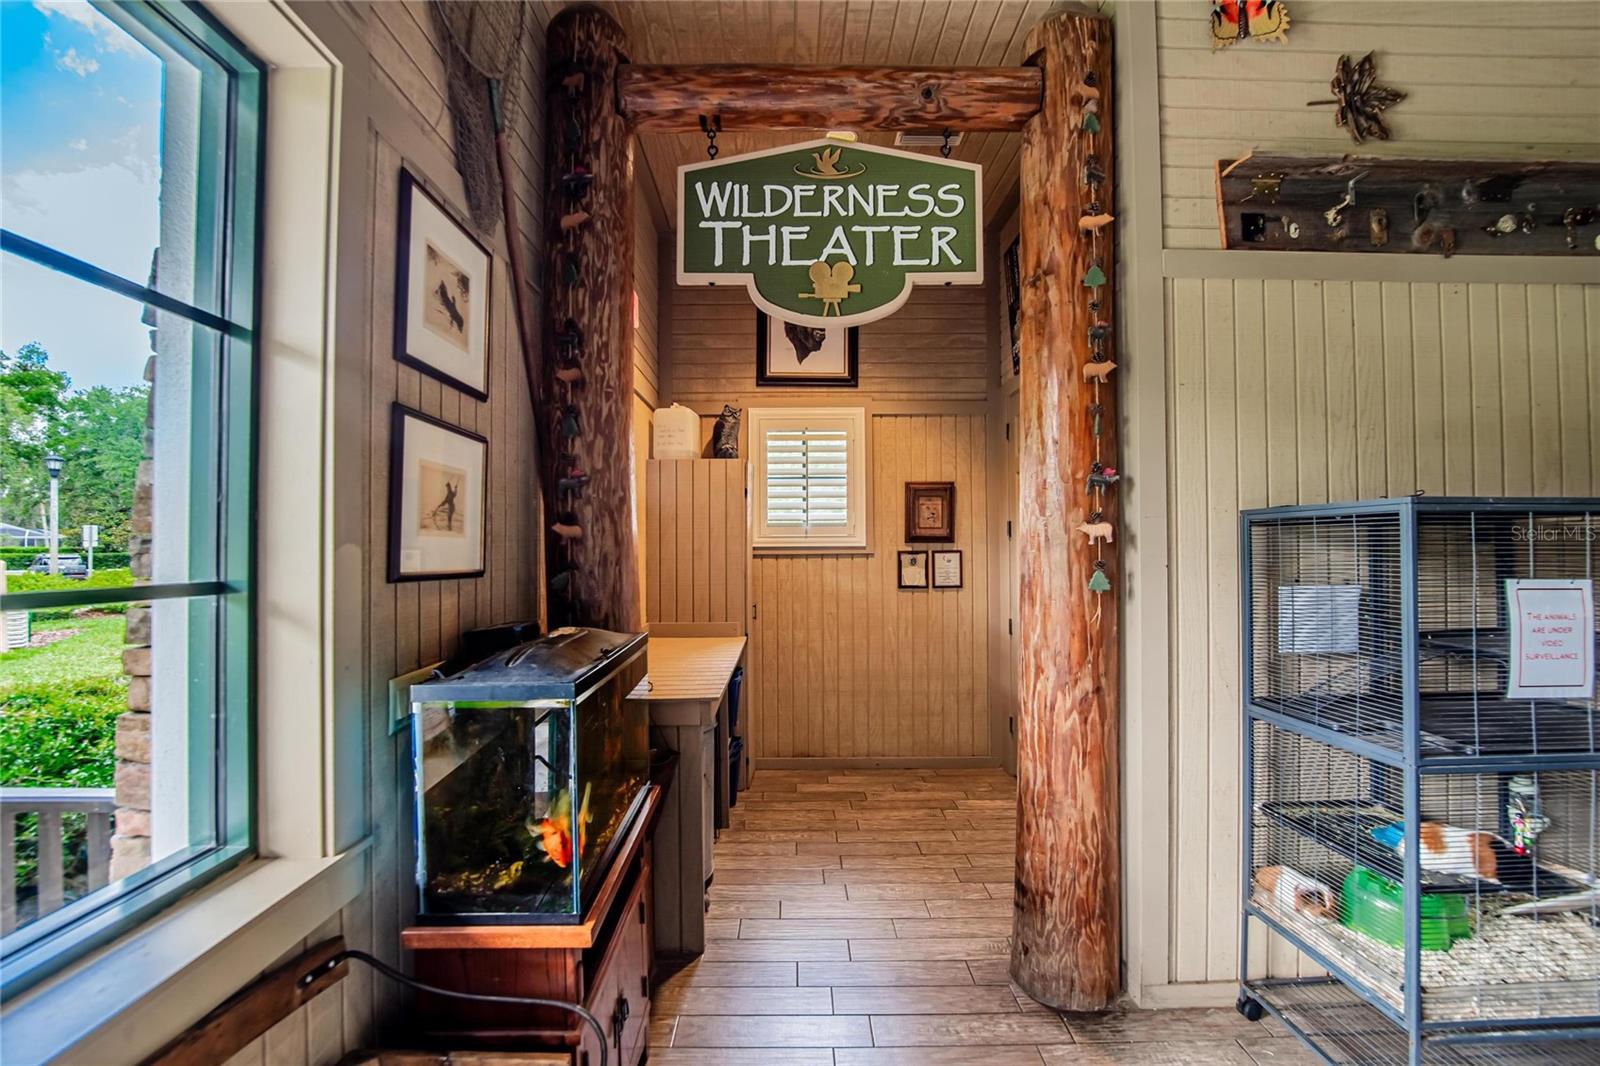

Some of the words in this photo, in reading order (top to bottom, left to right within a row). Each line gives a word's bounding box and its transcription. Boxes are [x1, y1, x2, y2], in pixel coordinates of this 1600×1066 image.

[694, 180, 965, 218] WILDERNESS
[698, 220, 963, 267] THEATER
[1527, 612, 1542, 621] THE
[1544, 612, 1576, 621] ANIMALS
[1532, 626, 1546, 634] ARE
[1548, 626, 1573, 634] UNDER
[1541, 639, 1564, 647] VIDEO
[1525, 652, 1578, 660] SURVEILLANCE
